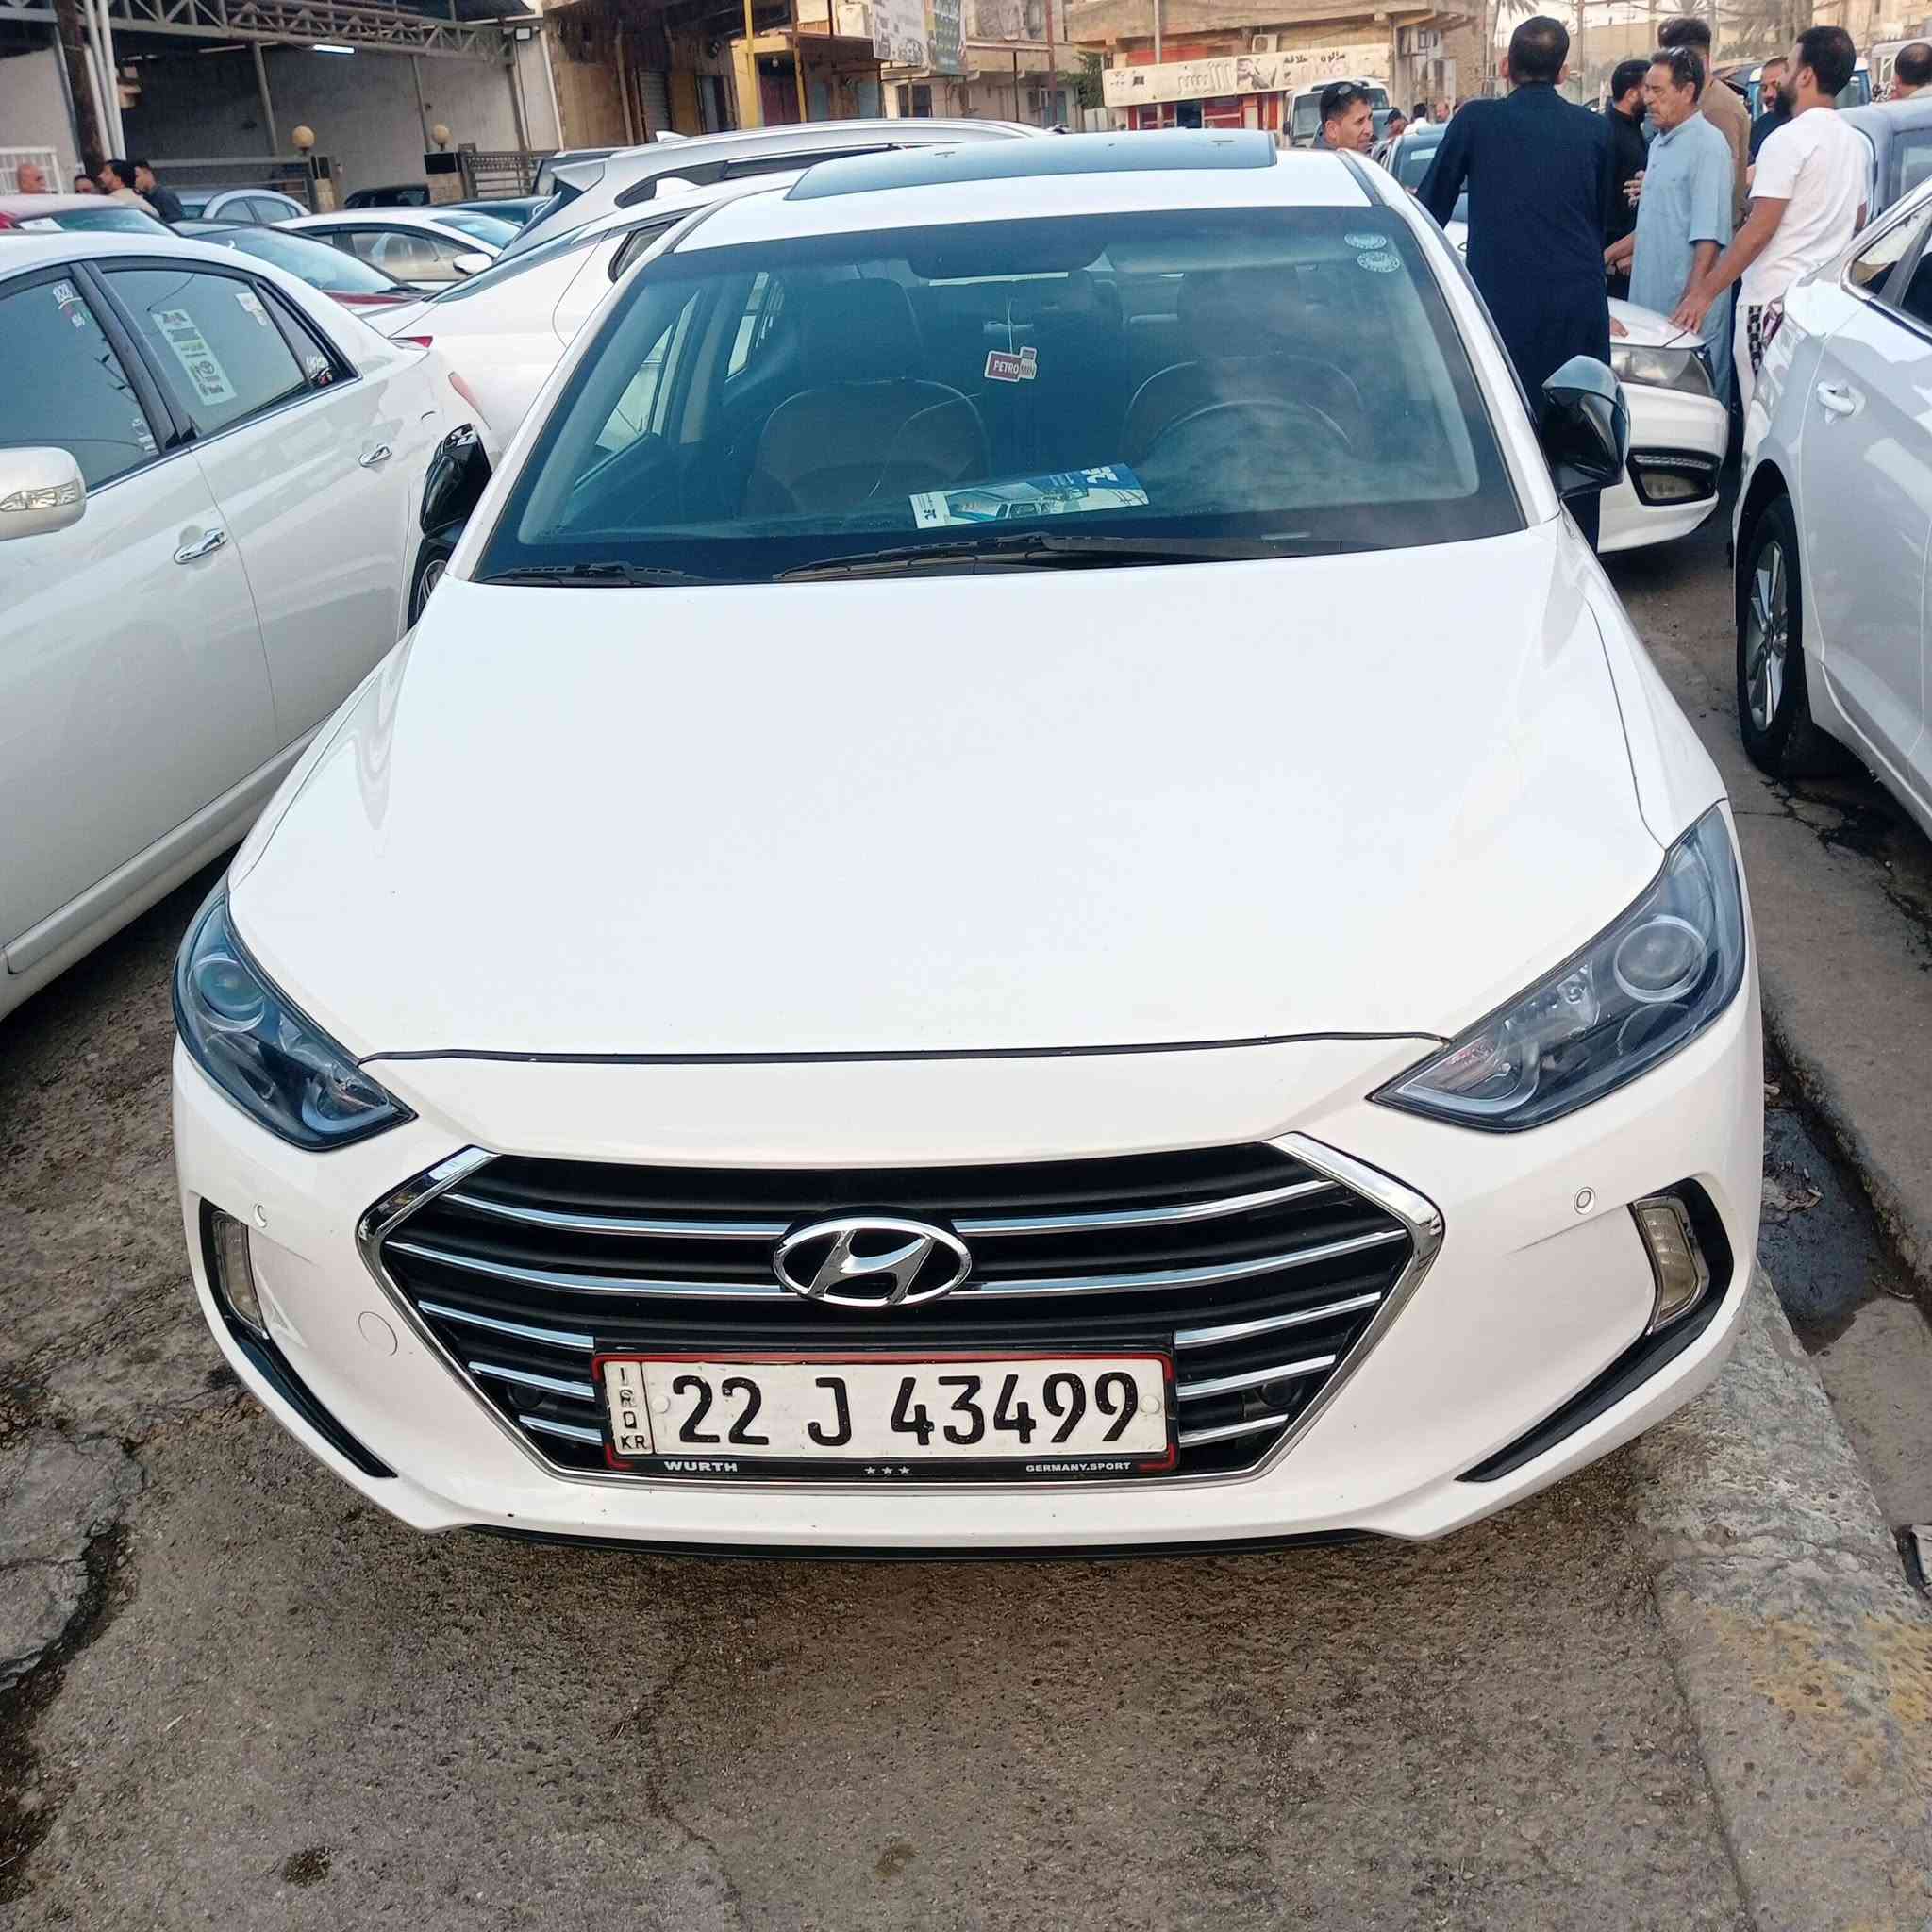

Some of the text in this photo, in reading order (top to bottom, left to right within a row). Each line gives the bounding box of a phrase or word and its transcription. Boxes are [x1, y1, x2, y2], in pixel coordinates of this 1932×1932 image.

[672, 1371, 1138, 1447] 22 J 43499
[663, 1460, 738, 1473] WURTH
